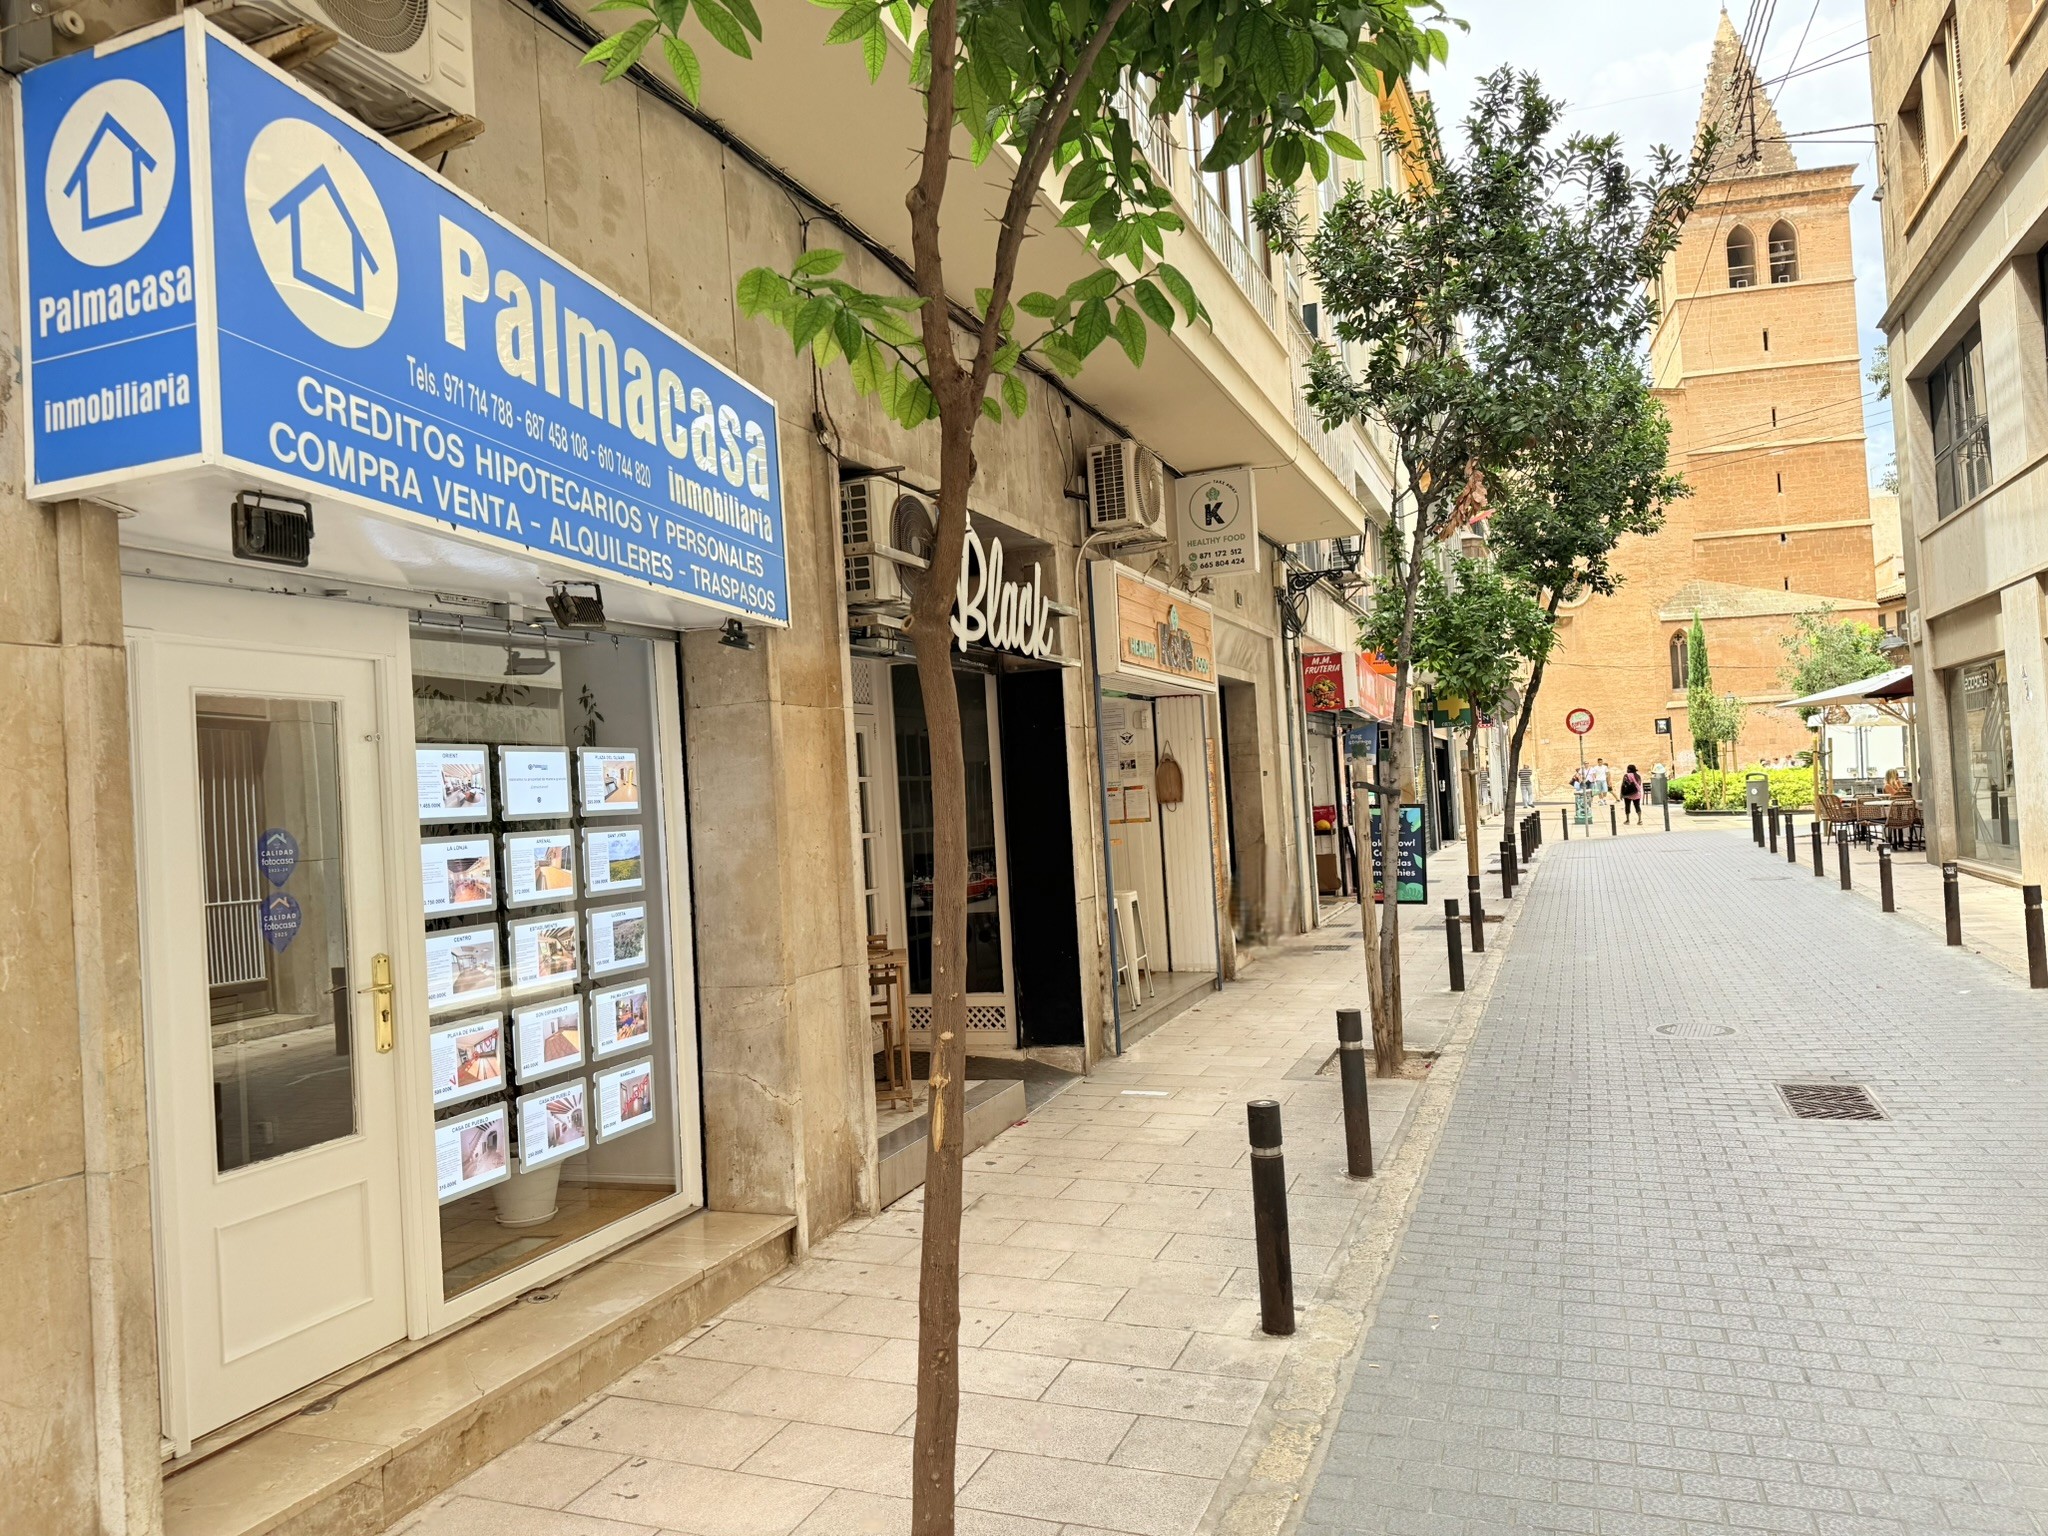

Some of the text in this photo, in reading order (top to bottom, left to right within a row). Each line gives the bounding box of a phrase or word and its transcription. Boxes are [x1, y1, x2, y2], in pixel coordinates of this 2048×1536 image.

[40, 265, 192, 338] Palmacasa
[439, 214, 770, 501] Palmacasa
[45, 373, 191, 433] inmobiliaria
[406, 354, 440, 398] Tels.
[443, 373, 465, 408] 971
[468, 383, 488, 418] 714
[491, 394, 513, 429] 788
[525, 410, 545, 442] 687
[549, 421, 568, 453] 458
[570, 431, 589, 462] 108
[598, 444, 614, 473] 610
[616, 452, 633, 481] 744
[635, 460, 651, 488] 820
[298, 376, 764, 577] CREDITOS HIPOTECARIOS Y PERSONALES
[1226, 484, 1238, 494] AWAY
[667, 466, 773, 543] inmobiliaria
[1204, 501, 1225, 526] K
[269, 421, 423, 504] COMPRA
[433, 475, 523, 535] VENTA
[531, 520, 541, 529] -
[549, 517, 673, 581] ALQUILERES
[690, 563, 776, 613] TRASPASOS
[1187, 534, 1246, 548] HEALTHY FOOD
[1200, 552, 1212, 560] 871
[950, 508, 1053, 660] Black
[1128, 636, 1156, 660] HEALTHY
[1305, 664, 1340, 675] FRUTERIA
[1311, 656, 1332, 665] M.M.
[261, 849, 294, 857] CALIDAD
[261, 857, 294, 866] fotocasa
[263, 913, 297, 922] CALIDAD
[263, 921, 297, 931] fotocasa
[453, 935, 472, 943] CENTRO
[451, 1125, 464, 1134] CASA
[471, 1116, 490, 1126] PUEBLO
